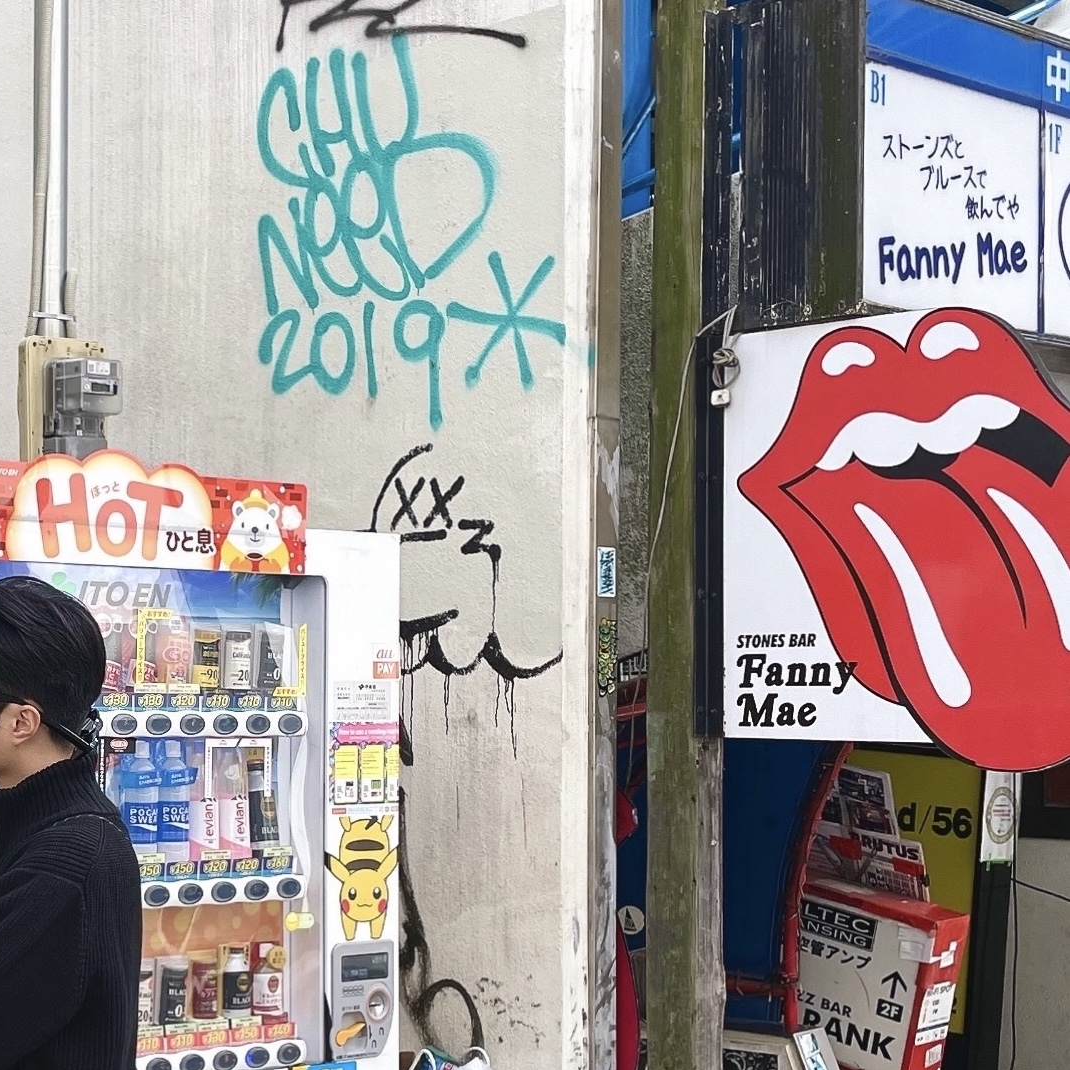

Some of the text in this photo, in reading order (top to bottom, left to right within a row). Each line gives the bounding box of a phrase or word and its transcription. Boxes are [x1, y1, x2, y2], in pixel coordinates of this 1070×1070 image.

[870, 70, 886, 106] B1
[882, 134, 964, 160] ストーンズと
[1049, 123, 1062, 154] 1F
[920, 165, 988, 191] ブルースで
[965, 195, 1019, 220] 飲んでや
[878, 232, 1027, 285] Fanny Mae
[90, 482, 121, 498] ほっと
[165, 528, 216, 555] ひと息
[78, 580, 172, 608] ITO EN
[736, 632, 816, 649] STONES BAR
[377, 663, 395, 674] PAY
[736, 654, 858, 695] Fanny
[736, 694, 817, 727] Mae
[205, 801, 214, 837] evian
[237, 800, 245, 835] evian
[821, 998, 852, 1018] BAR
[880, 1004, 900, 1017] 2F
